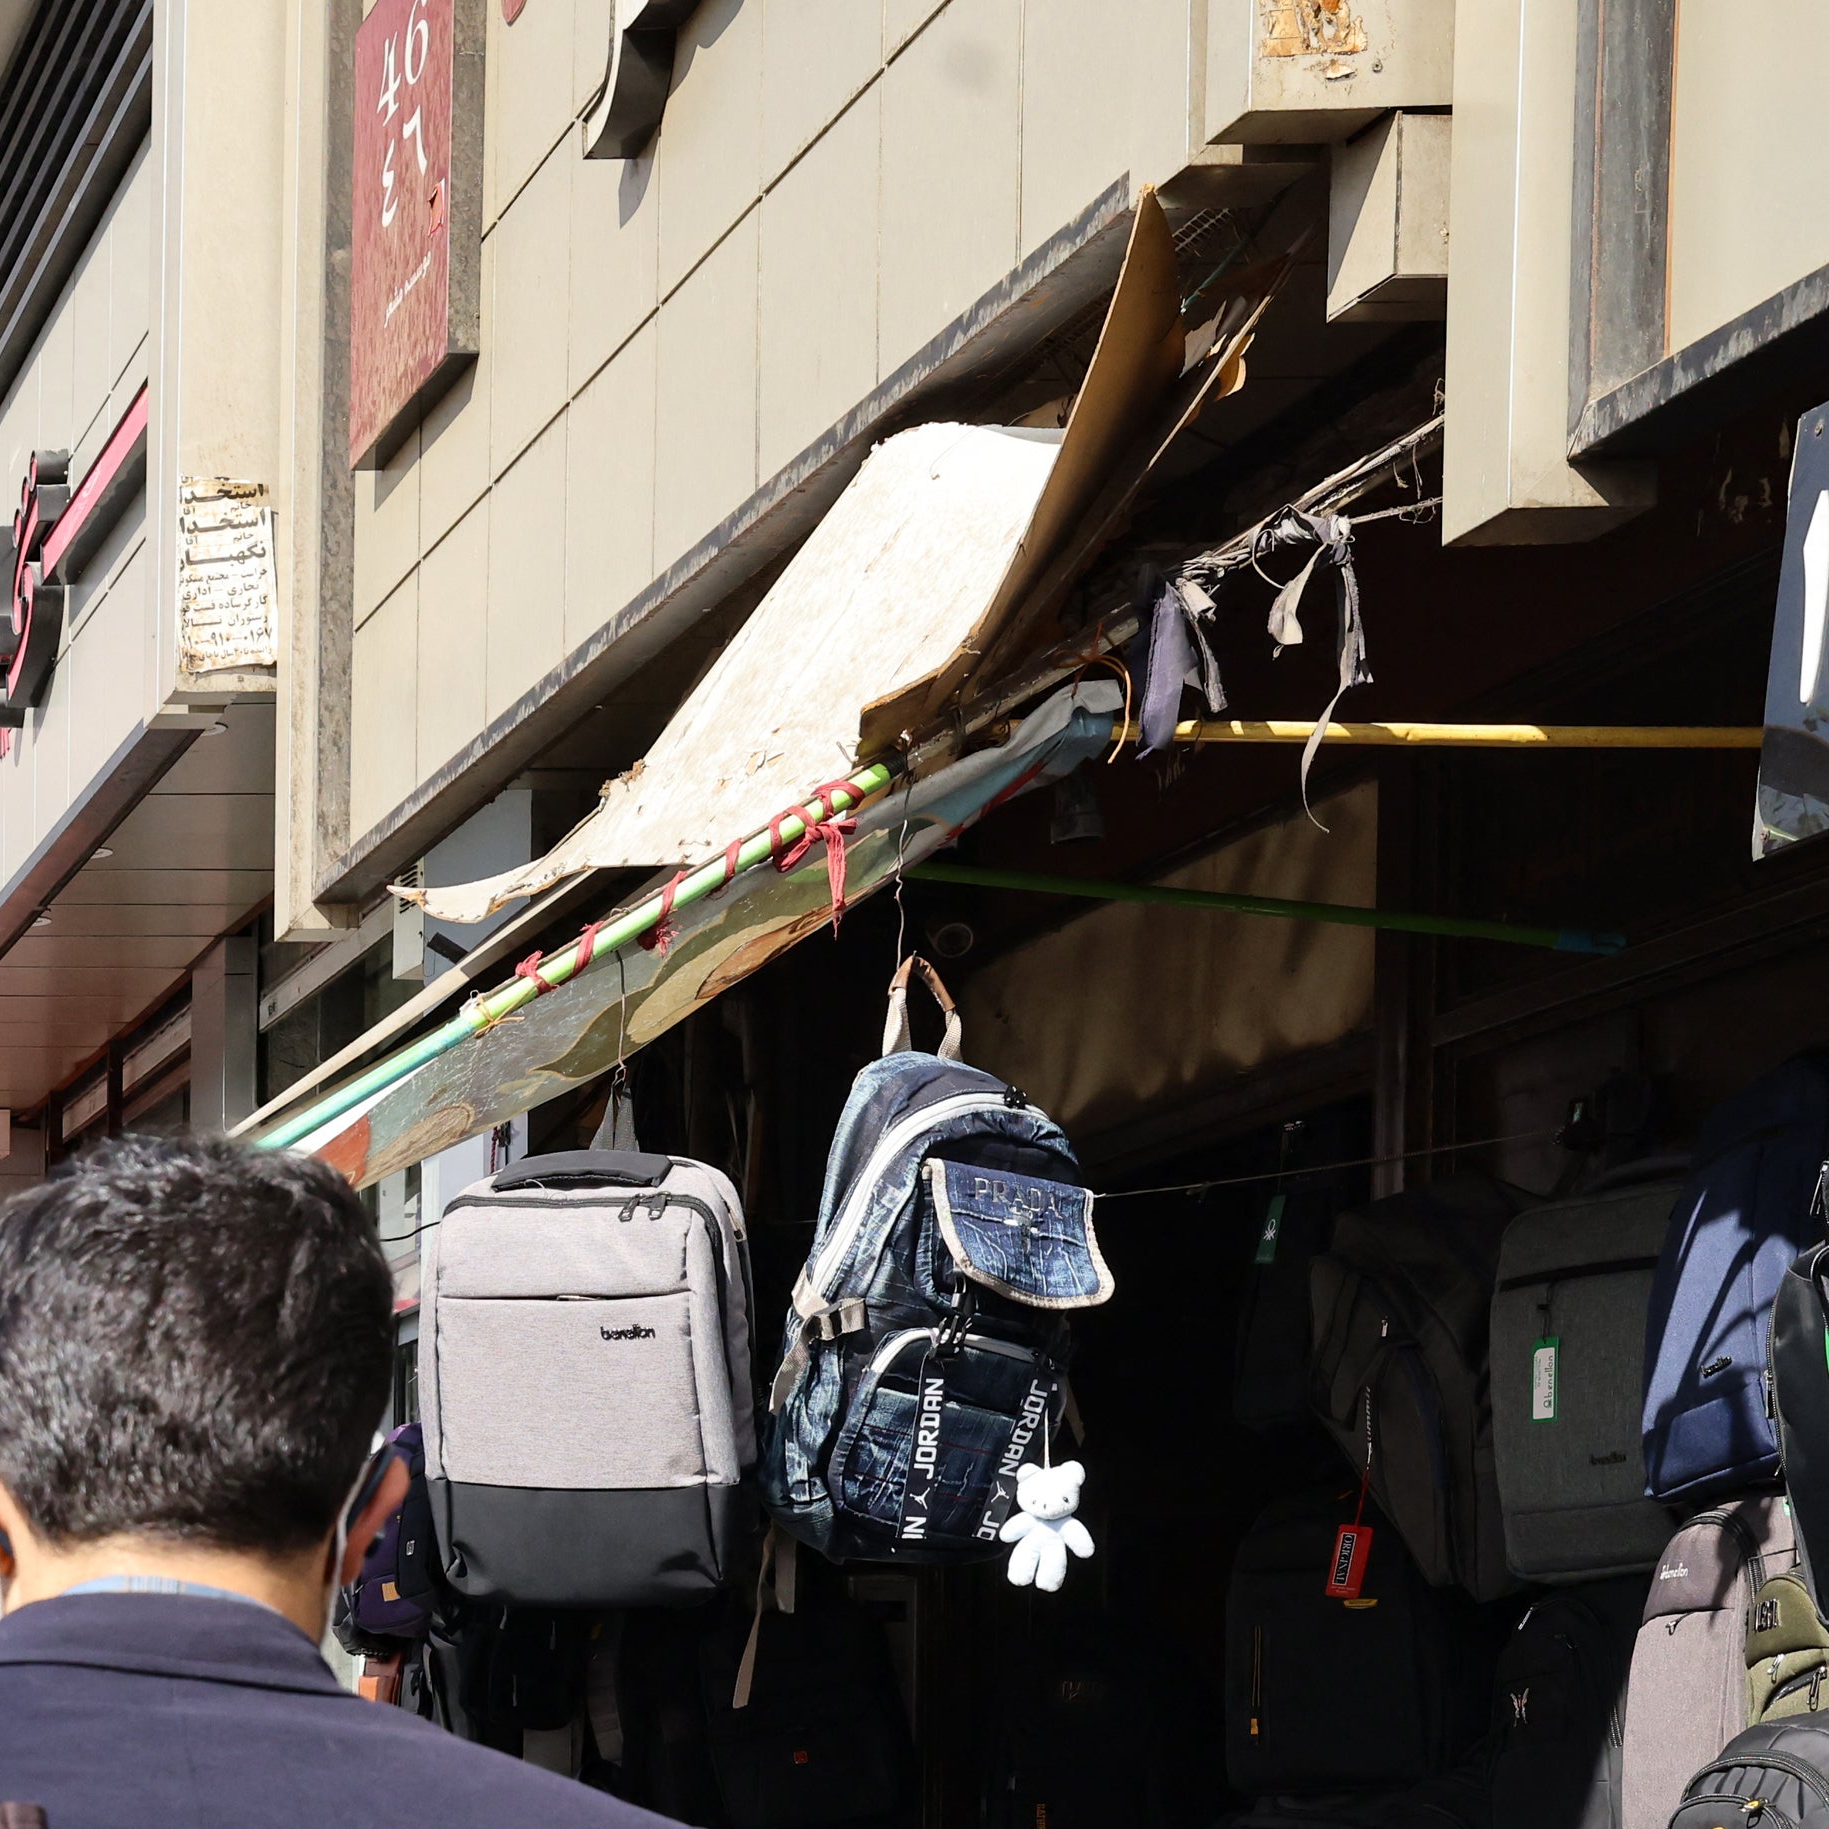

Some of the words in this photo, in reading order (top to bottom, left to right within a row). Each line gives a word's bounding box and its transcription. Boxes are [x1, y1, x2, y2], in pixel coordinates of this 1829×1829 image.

[377, 0, 430, 126] 46
[975, 1177, 1063, 1219] PRADA
[914, 1378, 944, 1480] JORDAN
[998, 1379, 1048, 1478] JORDAN
[1332, 1533, 1356, 1586] ORIGINAL
